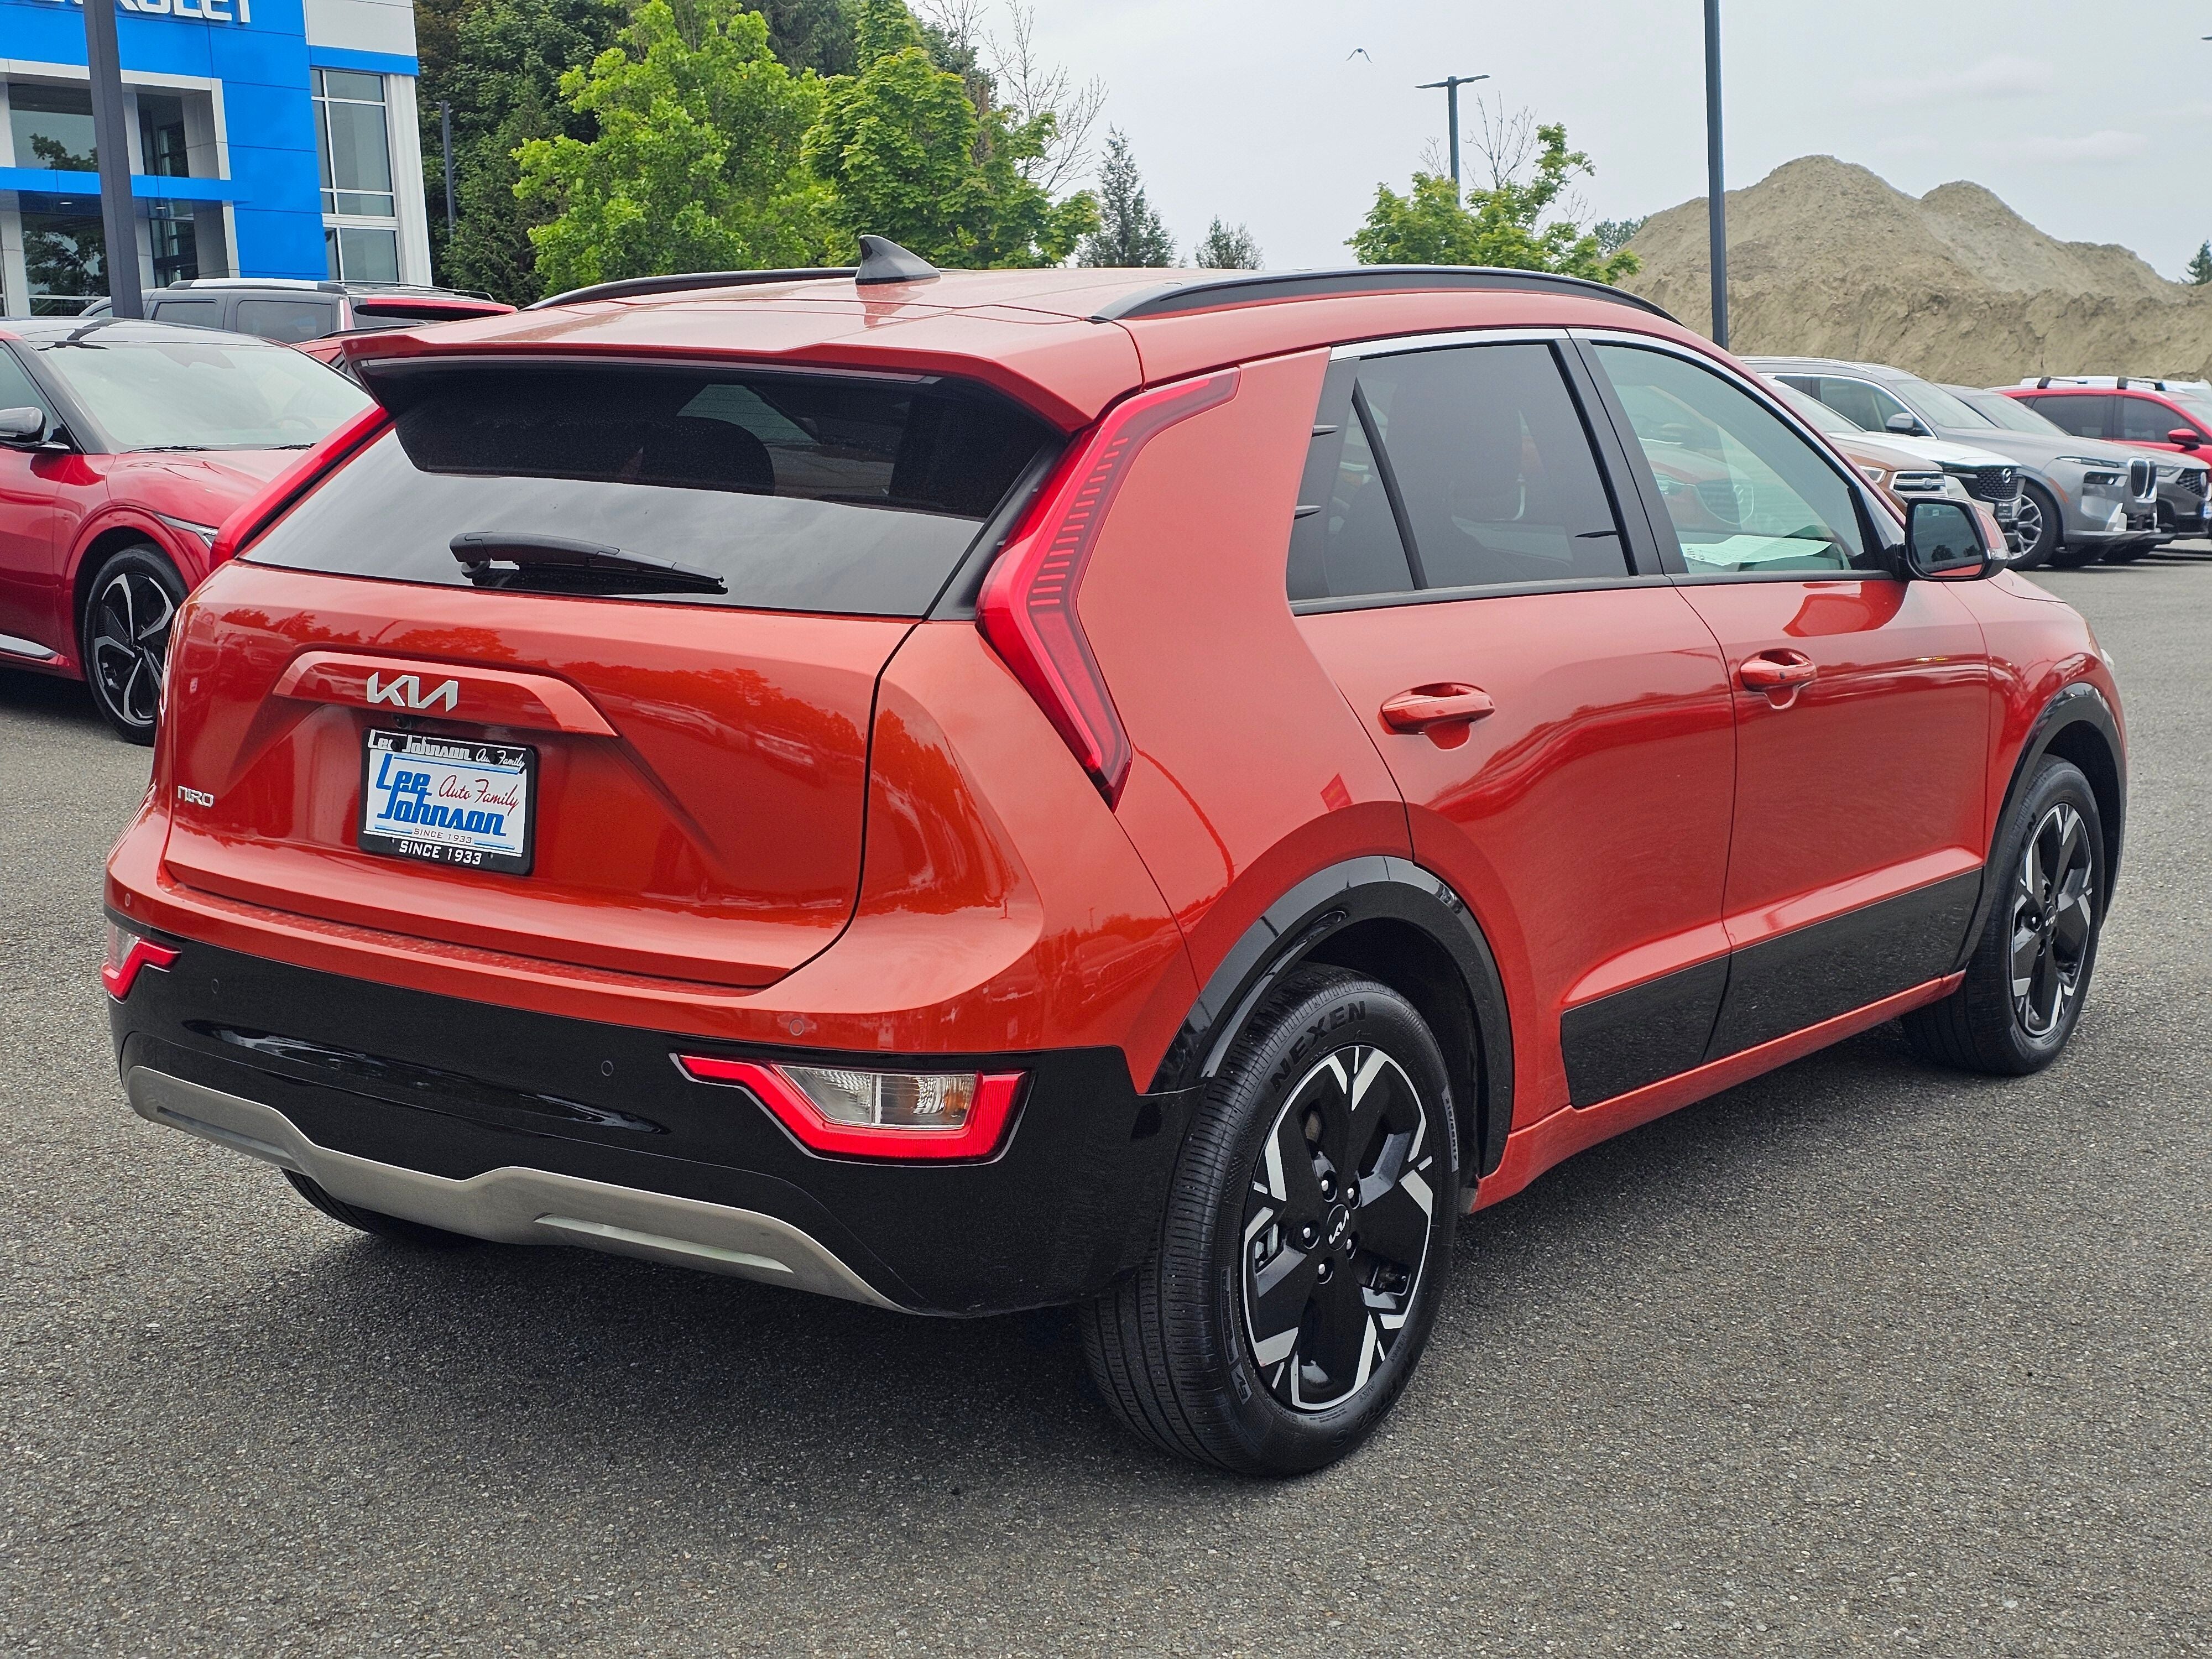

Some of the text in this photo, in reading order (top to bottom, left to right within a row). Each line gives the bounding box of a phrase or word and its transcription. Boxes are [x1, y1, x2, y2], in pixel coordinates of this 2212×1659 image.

[367, 671, 458, 712] KIA
[376, 753, 432, 793] Lee
[402, 734, 472, 761] Johnson
[476, 748, 494, 764] Au
[496, 750, 525, 772] Family
[178, 785, 214, 807] NIRO
[377, 787, 507, 837] Johnson
[439, 774, 519, 816] Auto Family
[399, 841, 482, 865] SINCE 1933
[413, 828, 472, 844] SINCE 1933
[1271, 1001, 1366, 1094] NEXEN
